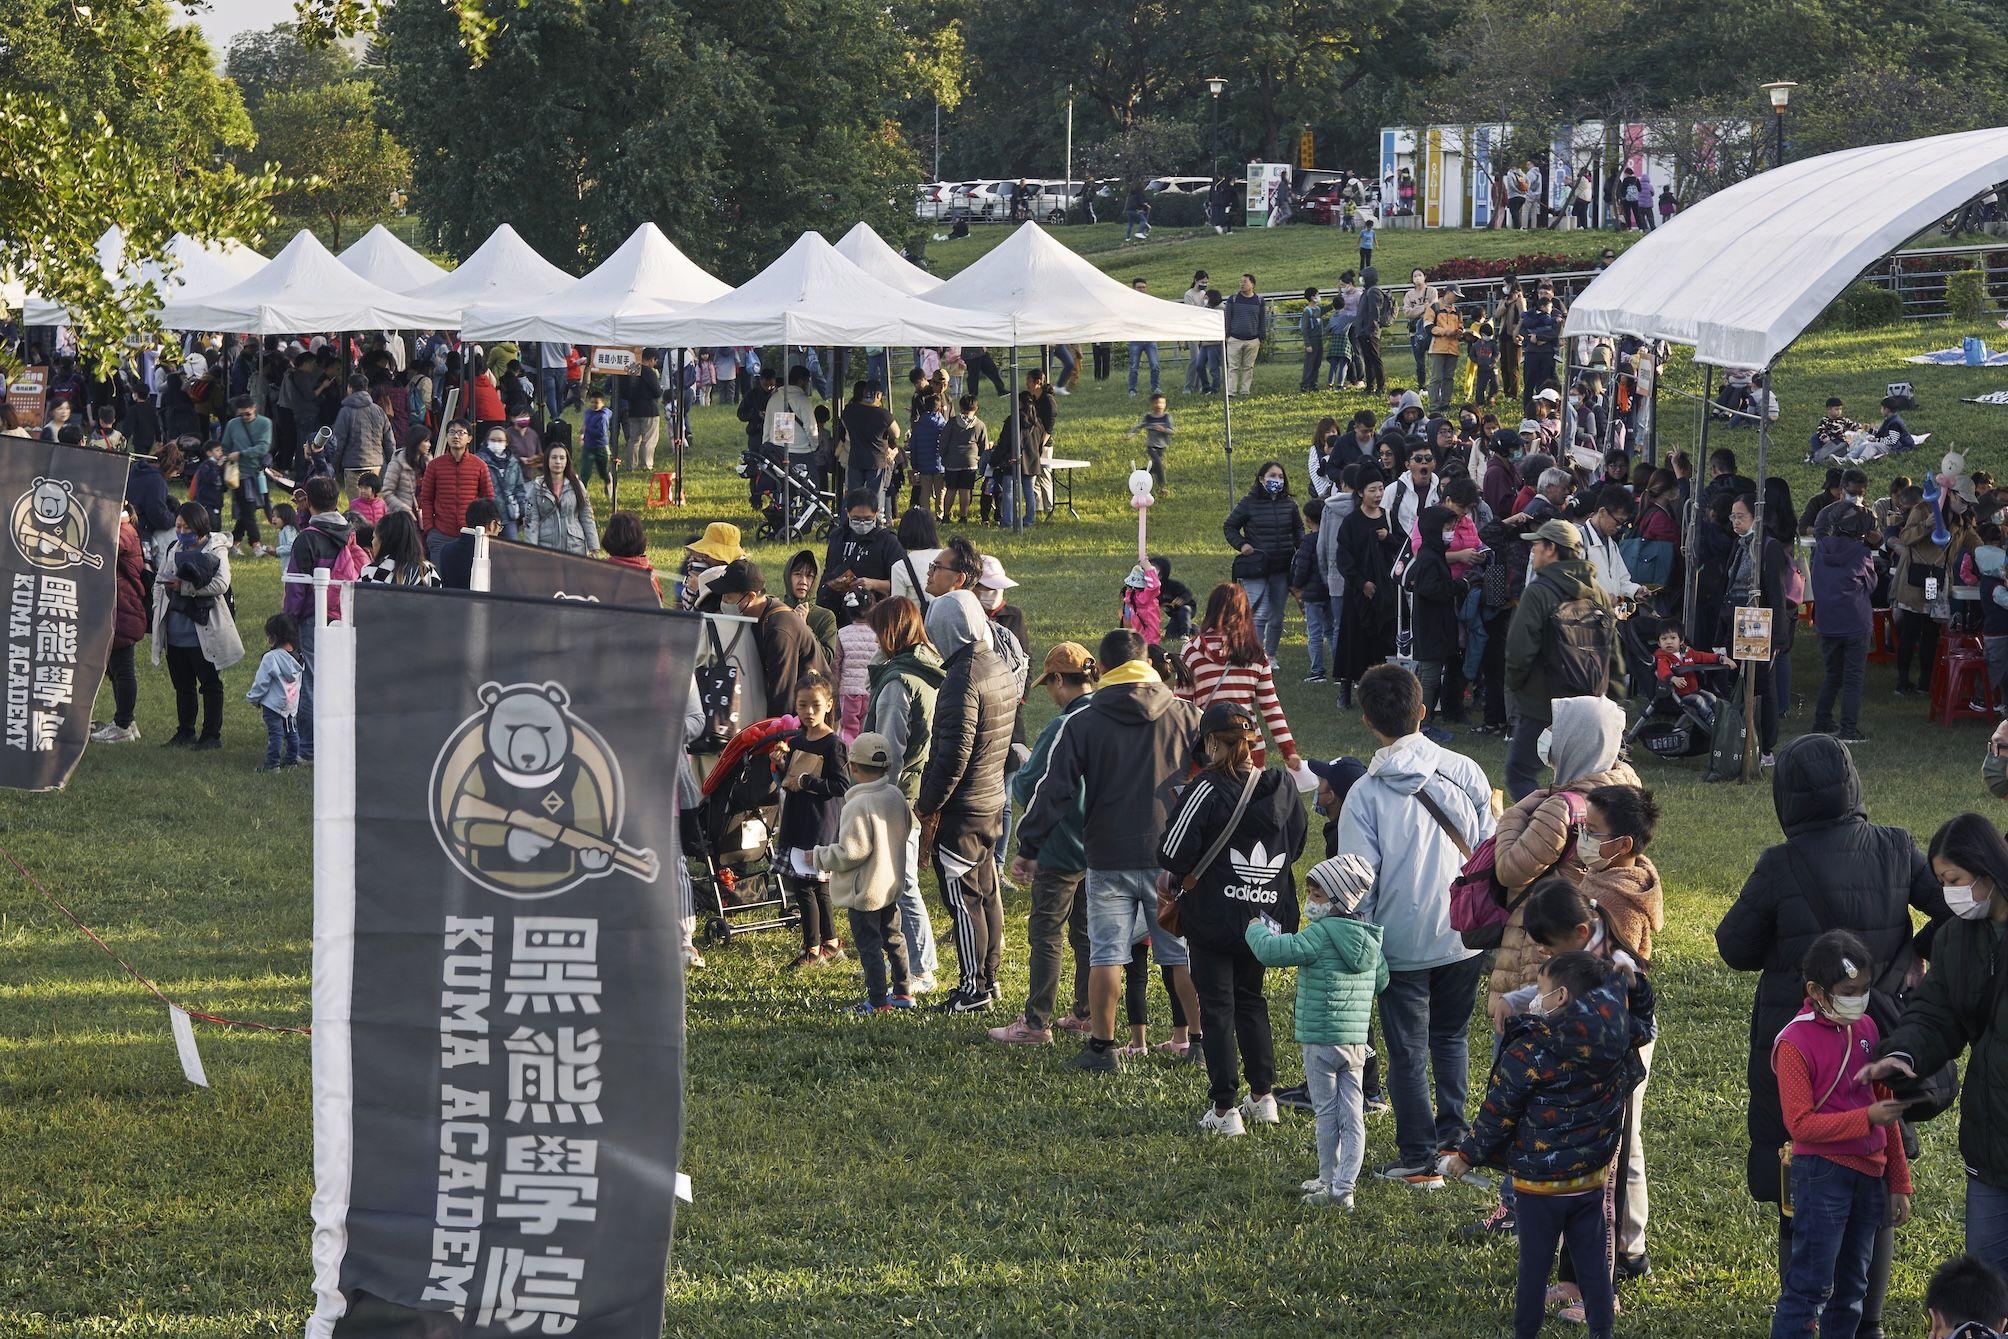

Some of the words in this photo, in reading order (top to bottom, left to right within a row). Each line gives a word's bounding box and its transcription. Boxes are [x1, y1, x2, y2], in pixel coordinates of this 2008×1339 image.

[9, 573, 35, 638] KUMA
[32, 575, 79, 752] 黑熊學院
[6, 643, 31, 751] ACADEMY
[1223, 884, 1278, 904] adidas
[439, 915, 495, 1069] KUMA
[475, 915, 603, 1335] 黑熊學院
